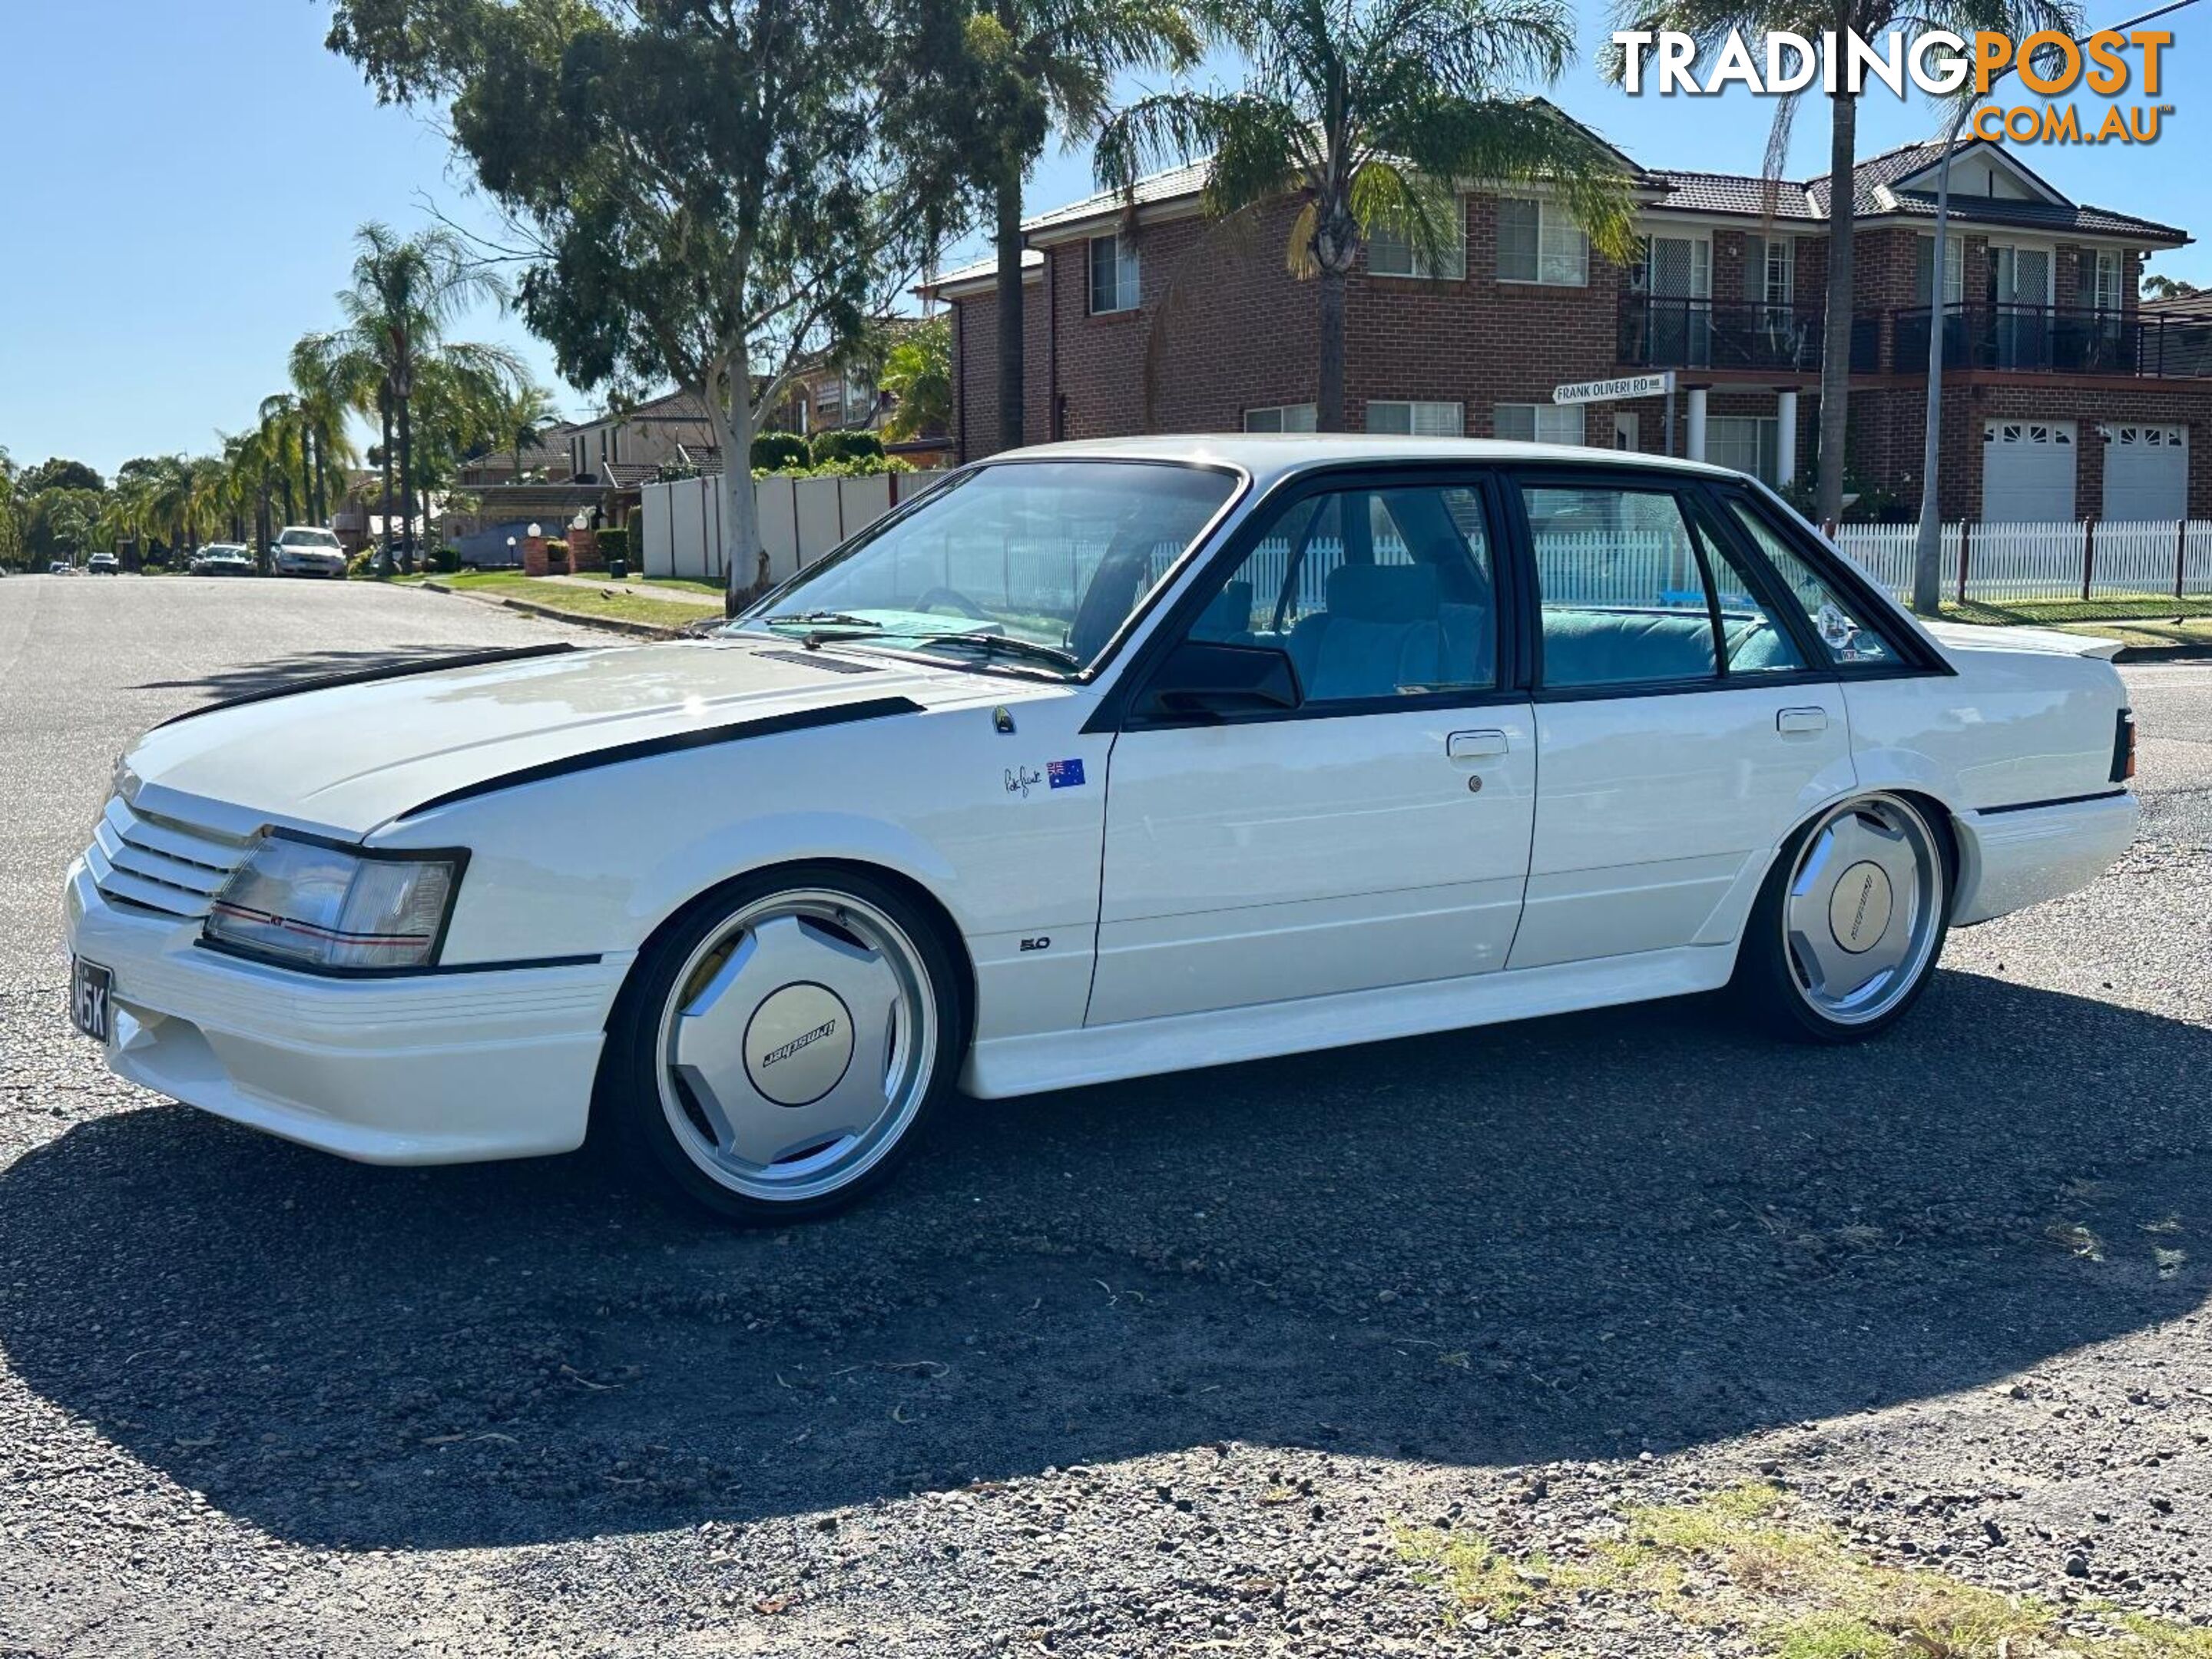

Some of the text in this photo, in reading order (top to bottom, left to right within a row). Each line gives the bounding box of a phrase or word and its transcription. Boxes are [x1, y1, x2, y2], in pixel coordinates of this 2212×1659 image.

[1558, 387, 1590, 399] FRANK
[1593, 381, 1631, 396] OLIVERI
[1634, 379, 1647, 392] RD
